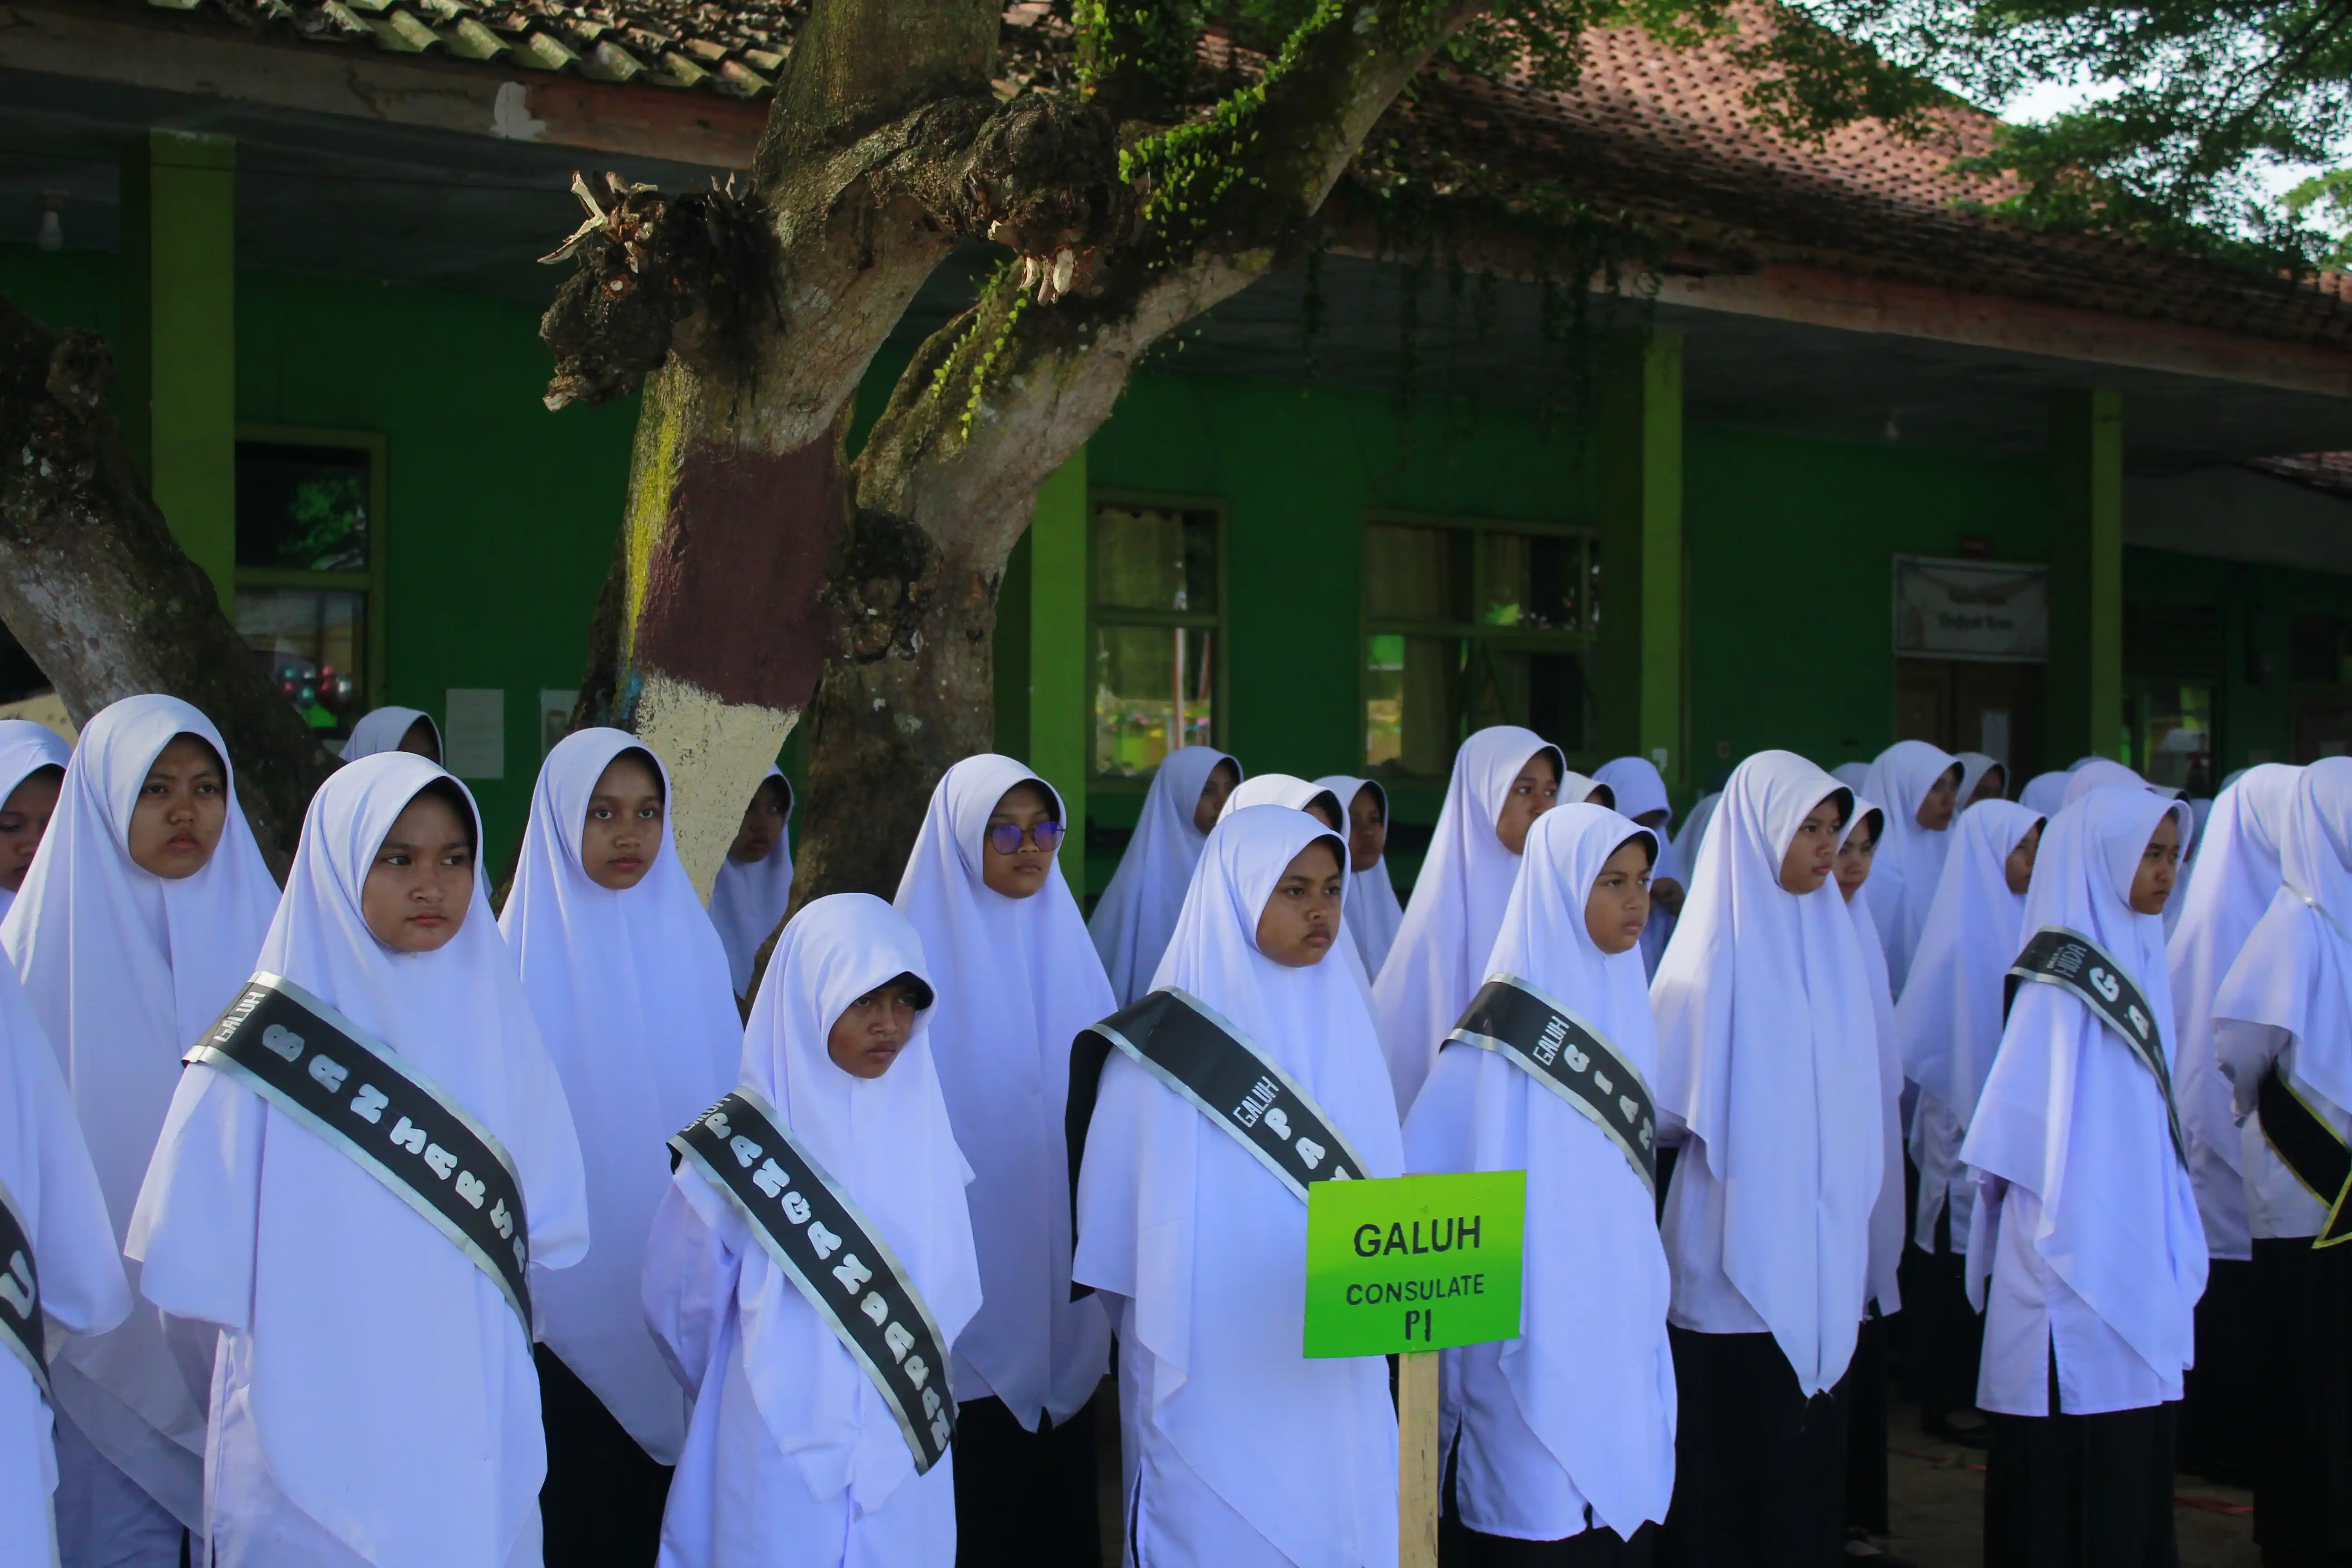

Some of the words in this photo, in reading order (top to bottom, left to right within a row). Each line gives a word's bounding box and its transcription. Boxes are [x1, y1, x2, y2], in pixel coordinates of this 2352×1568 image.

[213, 991, 266, 1043] GALUH
[1533, 1015, 1569, 1066] GALUH
[1233, 1076, 1279, 1127] GALUH
[1353, 1215, 1480, 1257] GALUH
[705, 1112, 951, 1452] PANGANDARAN
[1346, 1274, 1485, 1305] CONSULATE
[1405, 1309, 1431, 1342] PI
